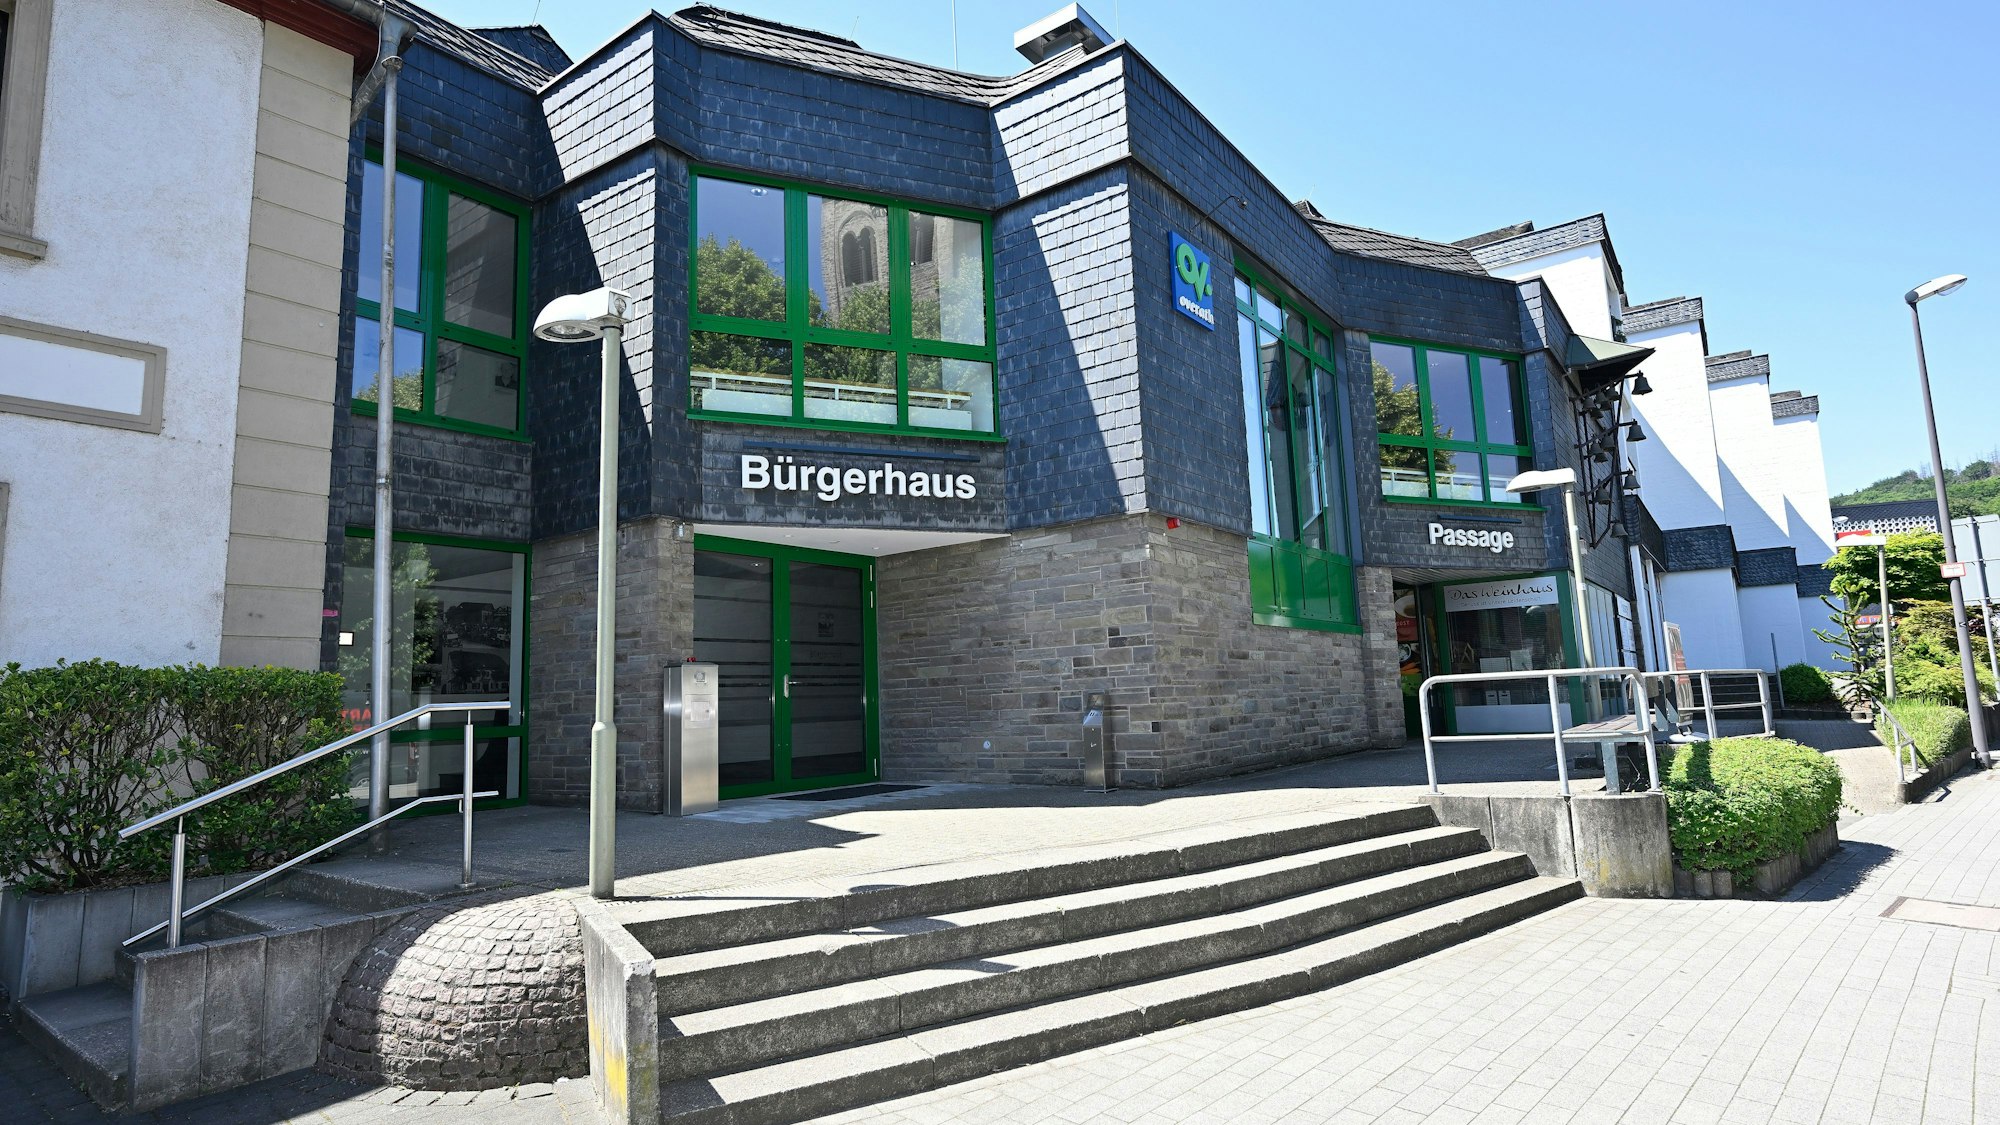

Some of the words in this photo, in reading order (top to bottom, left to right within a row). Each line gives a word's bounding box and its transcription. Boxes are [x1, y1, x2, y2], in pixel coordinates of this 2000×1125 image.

[1179, 295, 1215, 325] overath
[741, 454, 977, 501] Bürgerhaus
[1428, 522, 1514, 553] Passage
[1450, 589, 1477, 600] Das
[1481, 583, 1553, 599] Weinhaus
